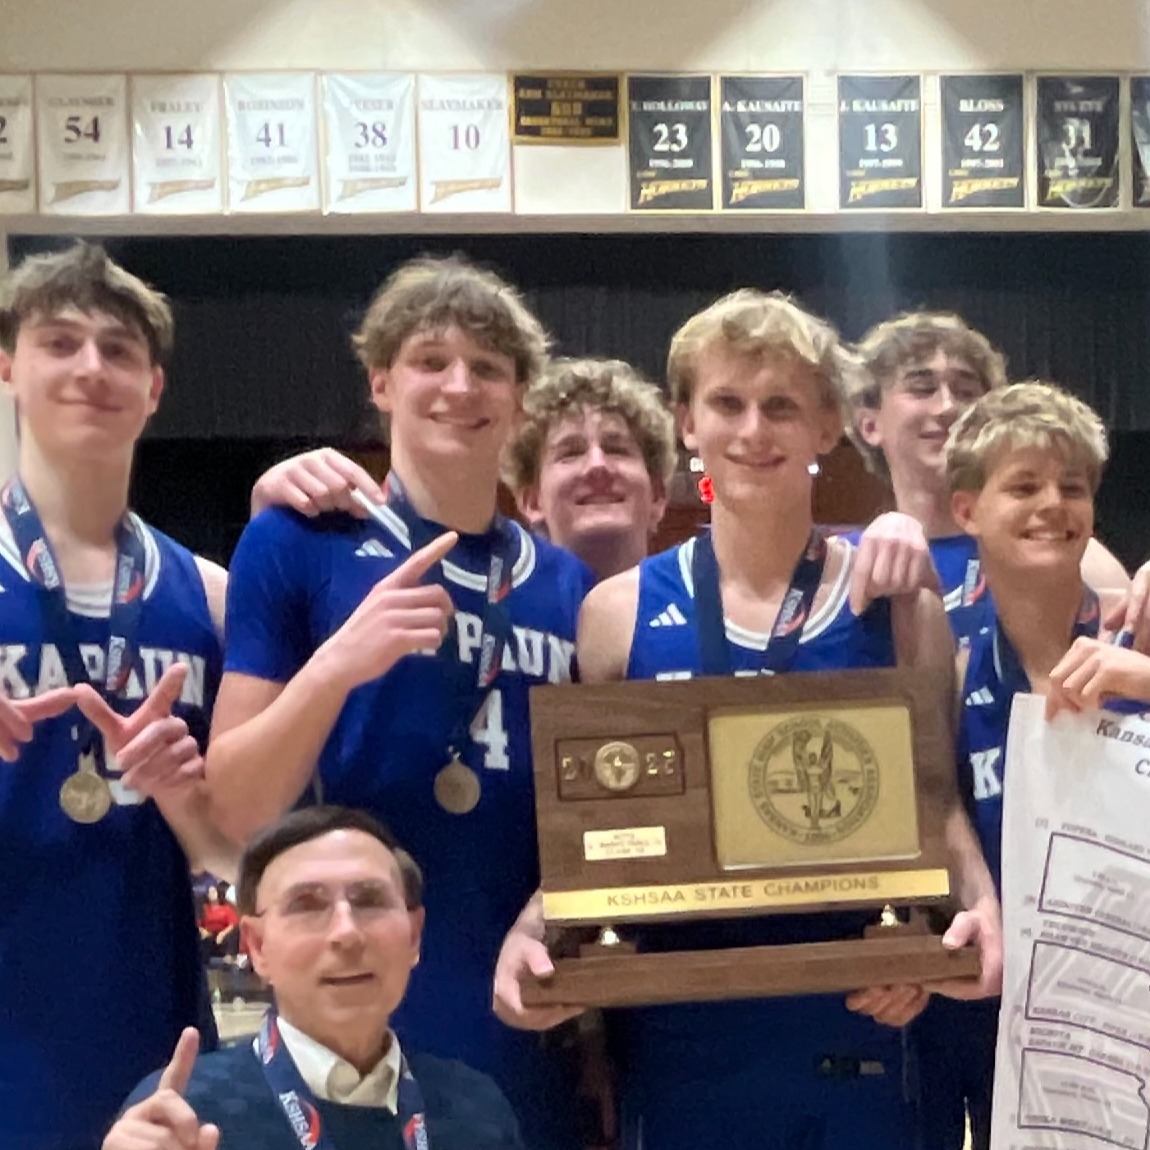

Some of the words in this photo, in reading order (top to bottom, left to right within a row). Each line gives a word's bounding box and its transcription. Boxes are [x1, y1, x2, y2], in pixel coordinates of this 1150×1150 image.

[64, 116, 100, 143] 54
[164, 124, 193, 149] 14
[256, 122, 288, 147] 41
[354, 122, 388, 148] 38
[449, 124, 480, 150] 10
[653, 123, 688, 151] 23
[745, 123, 780, 152] 20
[865, 123, 897, 152] 13
[964, 123, 1000, 152] 42
[470, 688, 510, 771] 4
[607, 886, 687, 907] KSHSAA
[694, 884, 754, 901] STATE
[763, 875, 880, 897] CHAMPIONS
